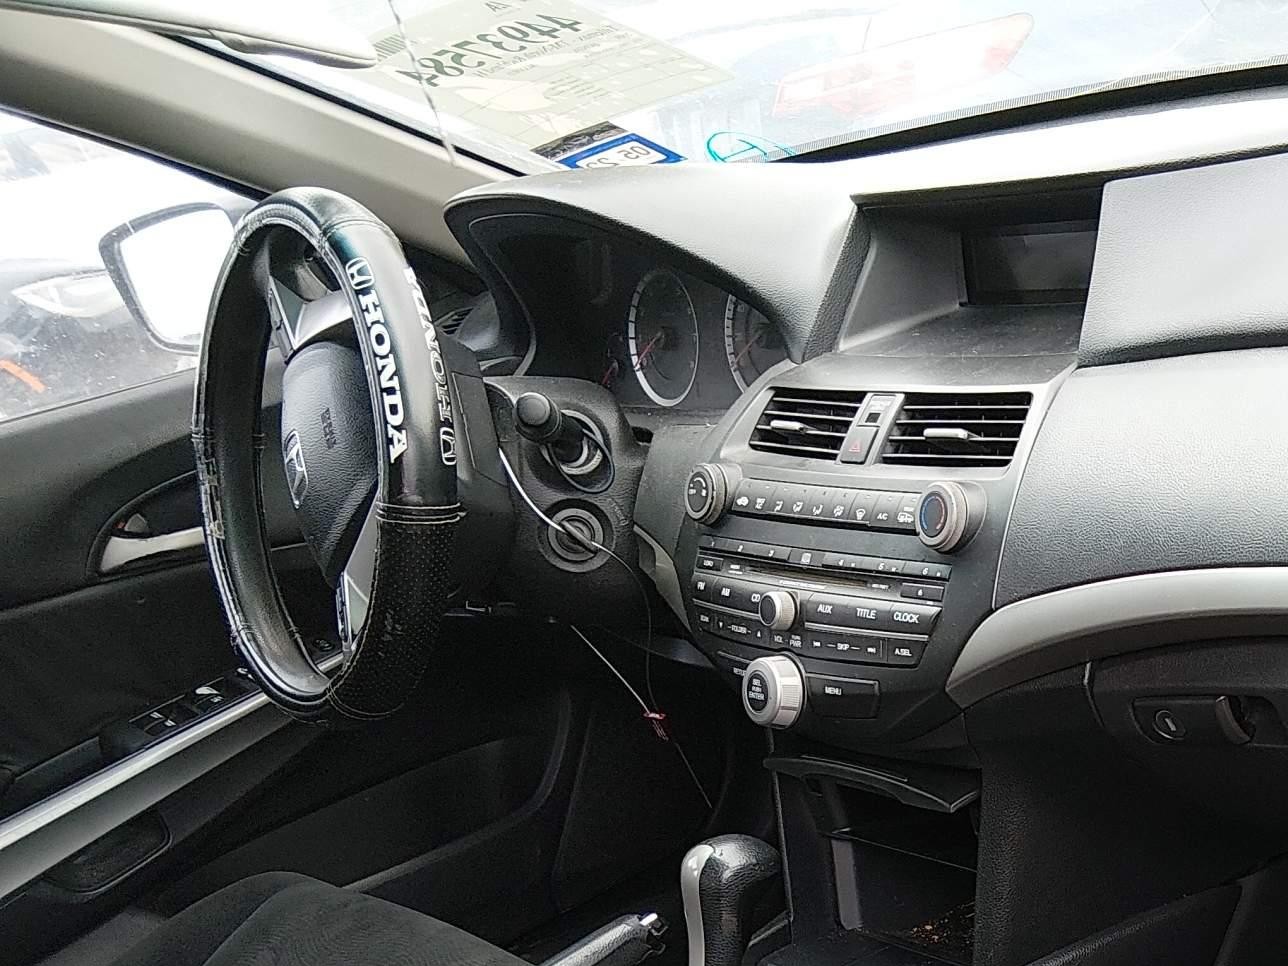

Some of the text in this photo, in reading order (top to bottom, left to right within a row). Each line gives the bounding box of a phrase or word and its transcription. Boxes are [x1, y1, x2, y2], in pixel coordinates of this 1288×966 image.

[358, 289, 408, 463] HONDA
[817, 603, 833, 615] AUX
[856, 607, 877, 620] TITLE
[893, 611, 920, 624] CLOCK
[824, 686, 842, 696] MENU
